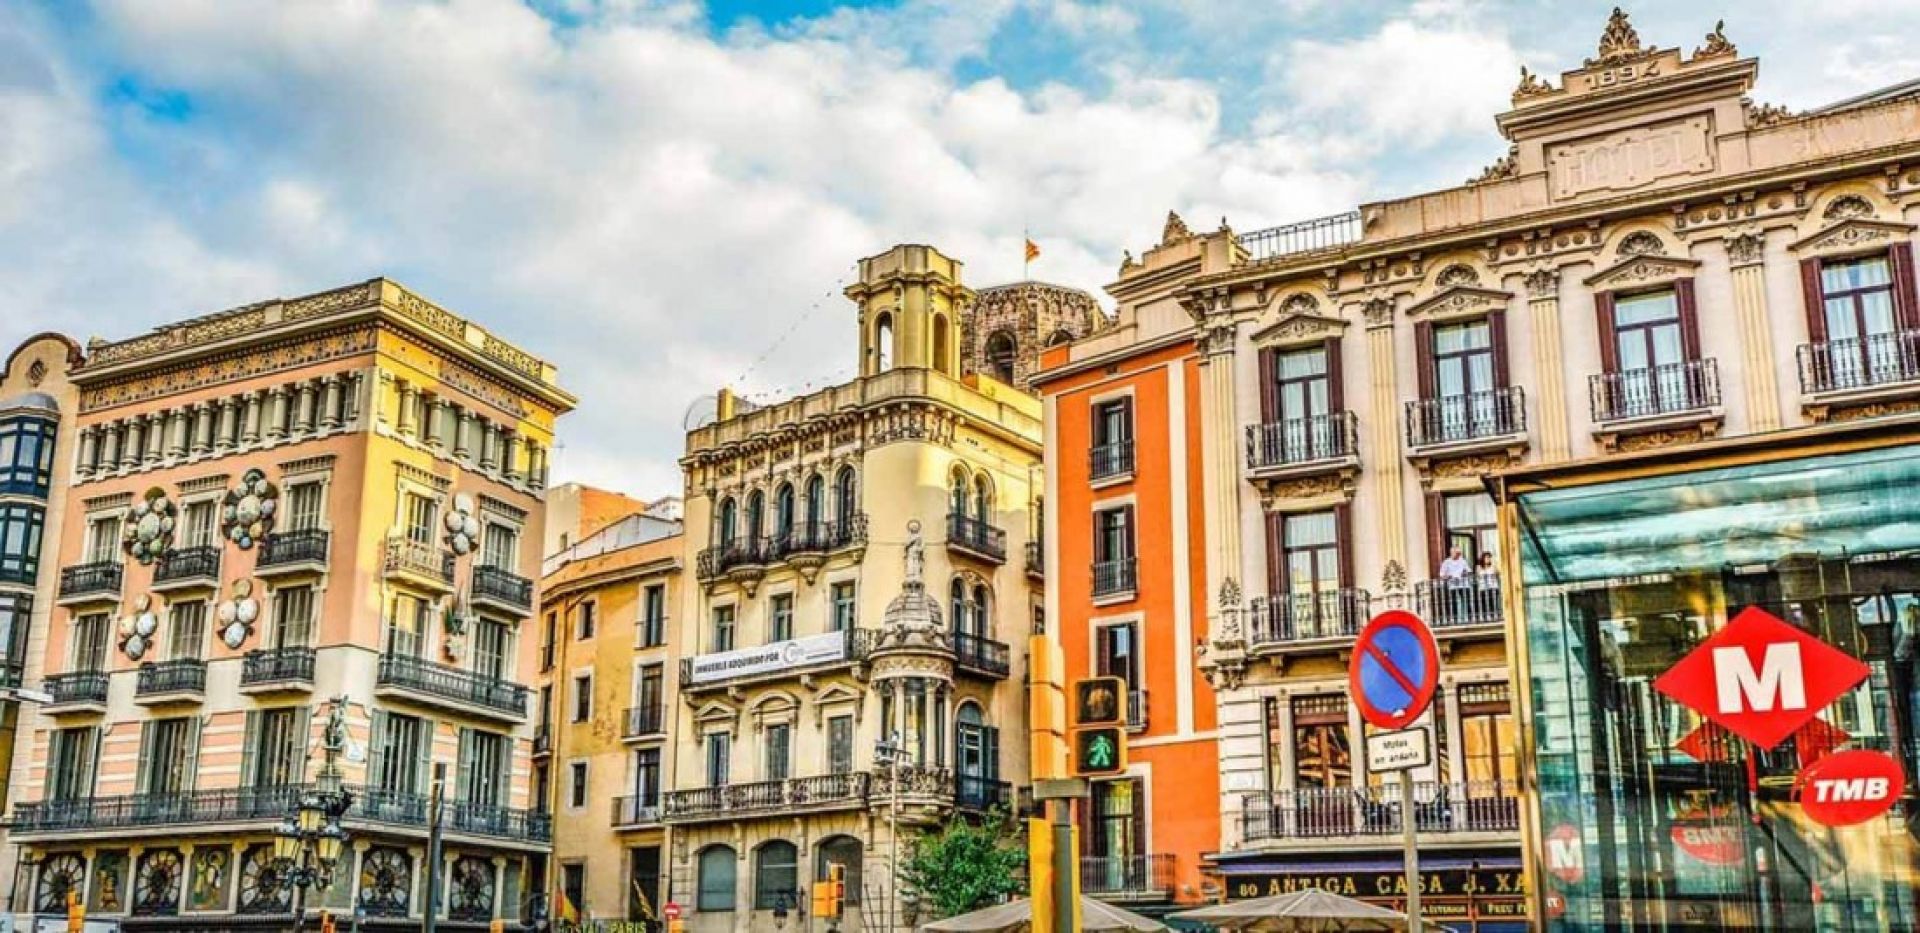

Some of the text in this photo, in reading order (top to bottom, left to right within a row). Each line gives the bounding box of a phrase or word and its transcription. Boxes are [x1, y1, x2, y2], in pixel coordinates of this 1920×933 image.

[1585, 60, 1660, 90] 1894
[1557, 131, 1698, 186] HOTEL
[1713, 641, 1807, 714] M
[1814, 777, 1890, 803] TMB
[1551, 838, 1582, 869] M
[1269, 876, 1357, 896] ANTIGA
[1376, 873, 1444, 895] CASA
[1462, 873, 1485, 893] J.
[1496, 873, 1525, 893] XA
